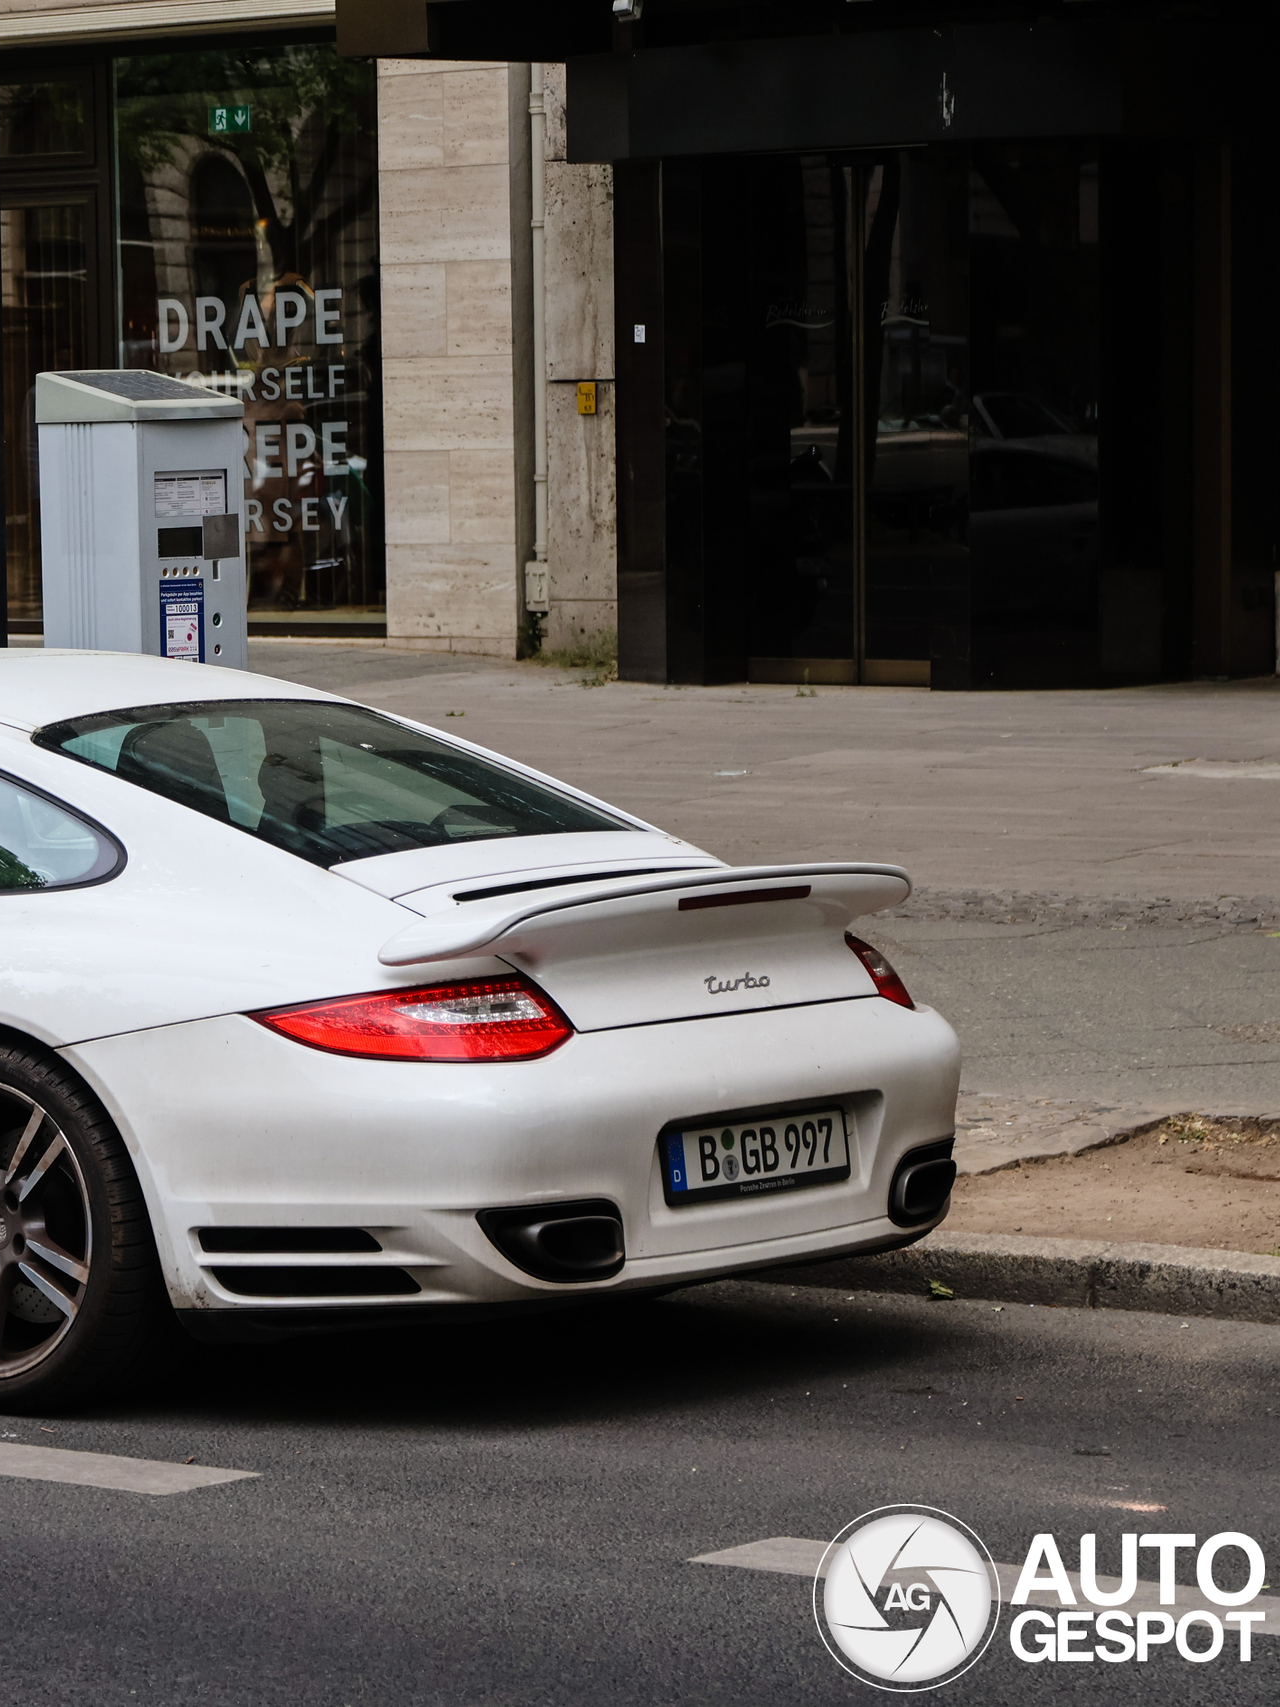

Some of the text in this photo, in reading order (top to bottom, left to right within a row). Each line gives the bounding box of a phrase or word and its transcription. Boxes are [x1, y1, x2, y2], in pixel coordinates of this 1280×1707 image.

[157, 288, 344, 353] DRAPE
[244, 421, 350, 479] EPE
[245, 497, 348, 532] RSEY
[175, 604, 197, 612] 100013
[698, 1117, 833, 1182] B GB 997
[673, 1169, 682, 1183] D
[739, 1183, 759, 1193] Porsche
[782, 1177, 795, 1187] Berlin
